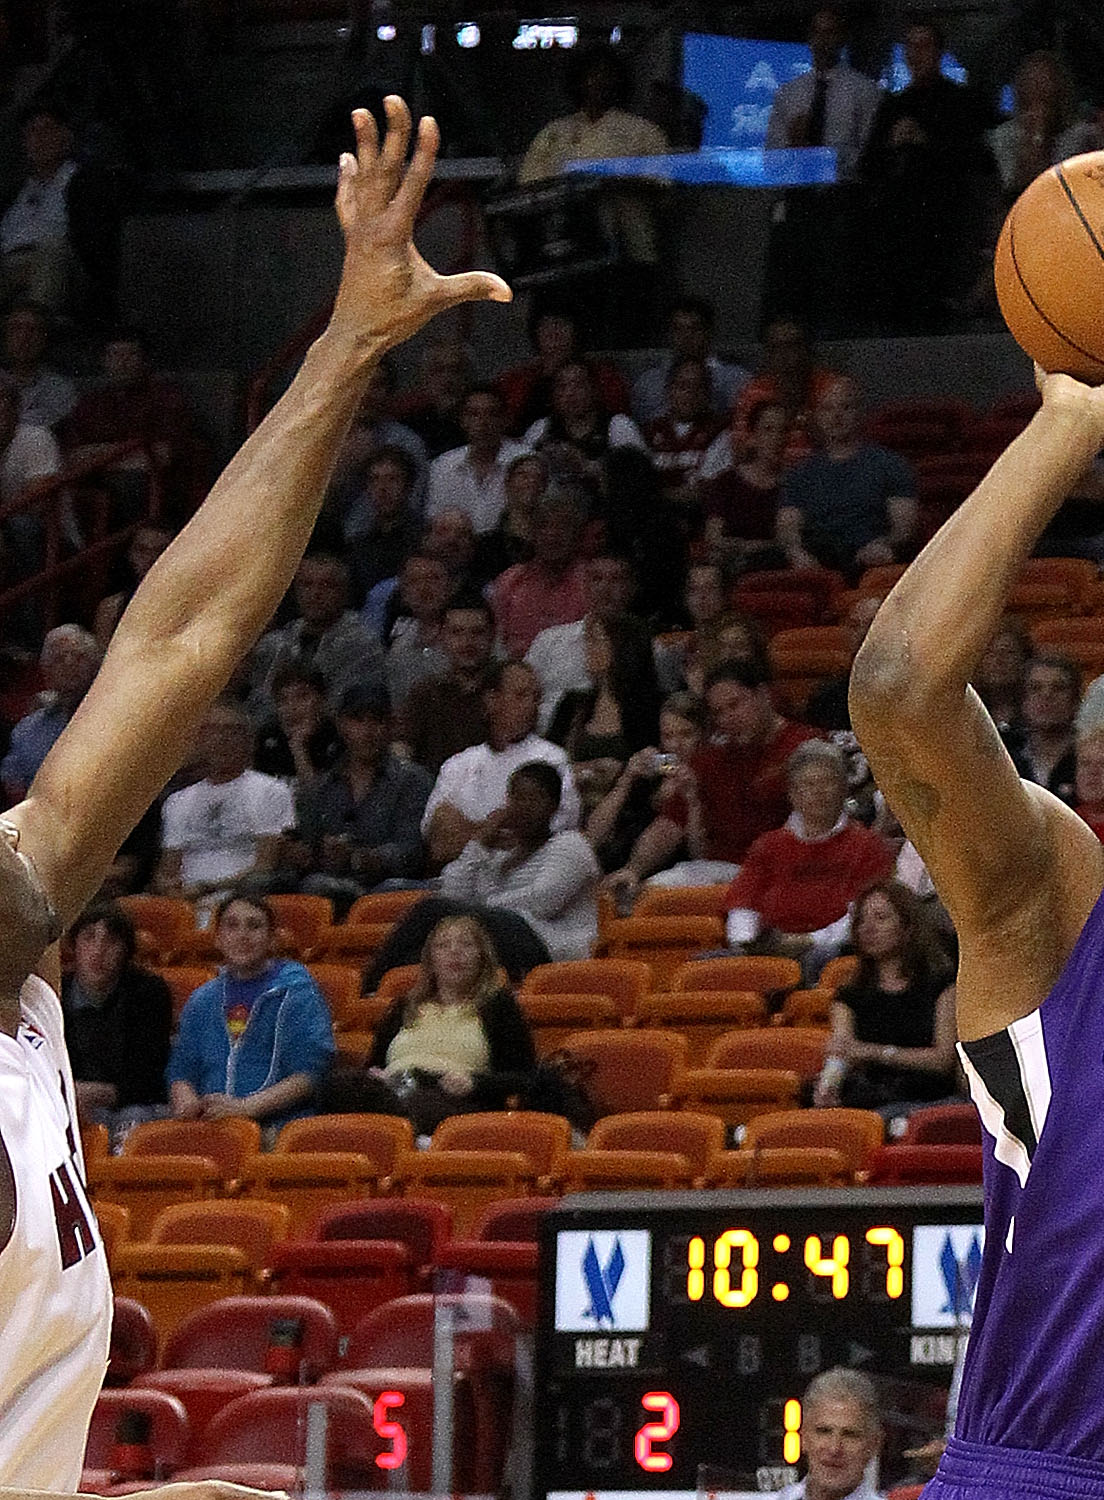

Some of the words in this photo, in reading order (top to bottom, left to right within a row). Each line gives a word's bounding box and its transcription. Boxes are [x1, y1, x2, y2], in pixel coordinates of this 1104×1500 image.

[687, 1227, 904, 1308] 10:47
[575, 1338, 640, 1368] HEAT
[634, 1391, 681, 1472] 2
[783, 1398, 801, 1464] 1
